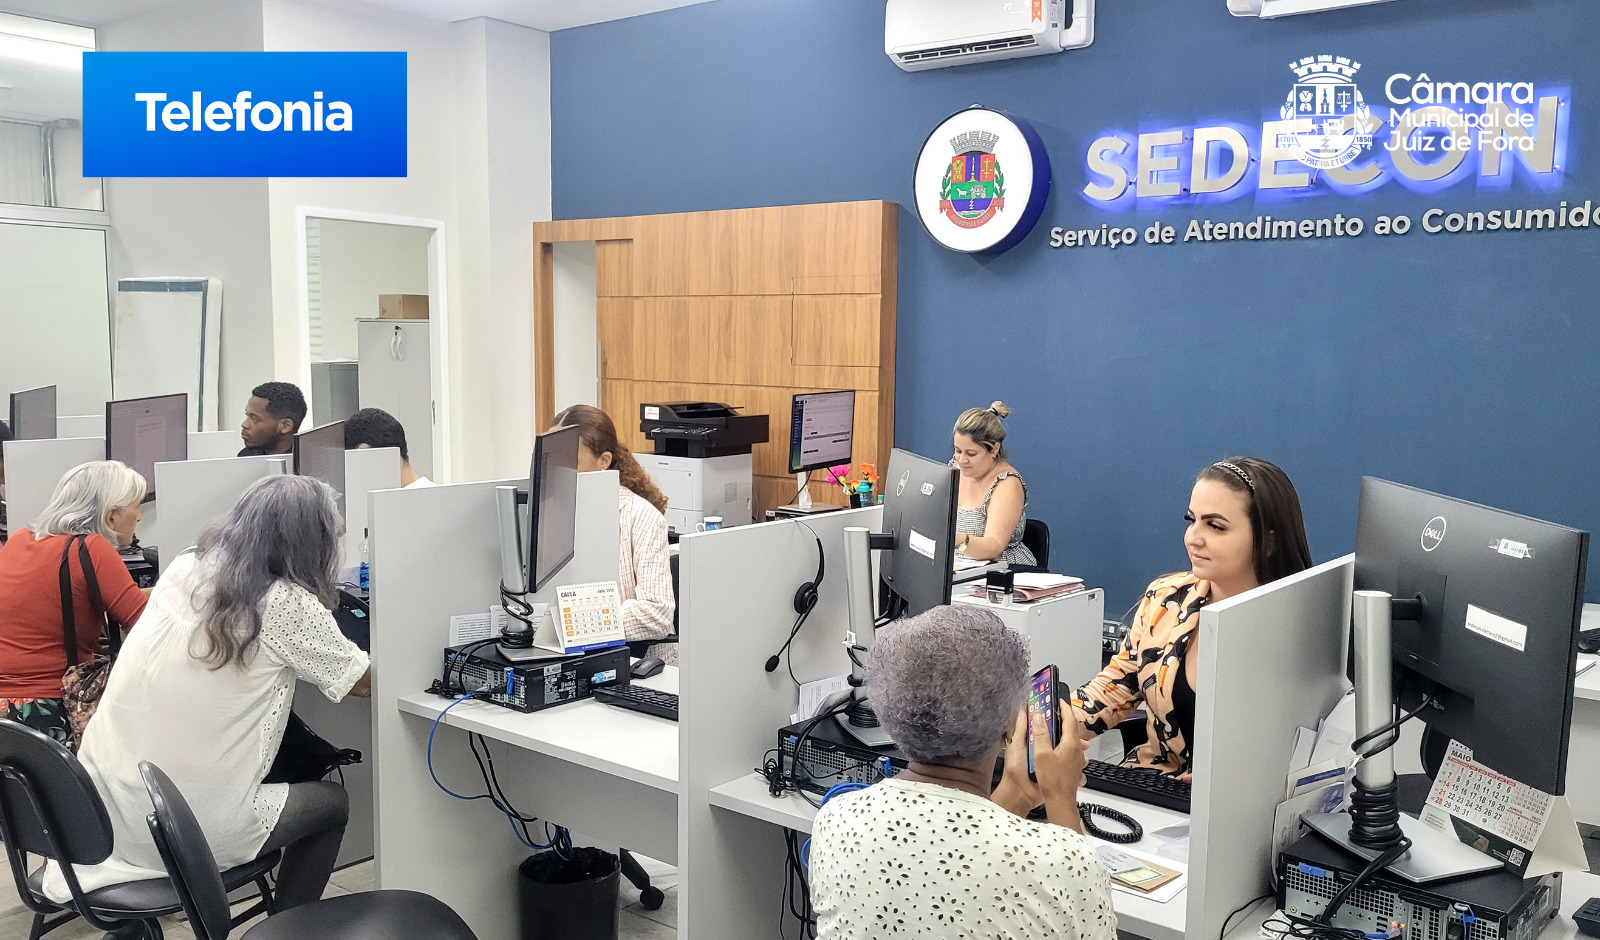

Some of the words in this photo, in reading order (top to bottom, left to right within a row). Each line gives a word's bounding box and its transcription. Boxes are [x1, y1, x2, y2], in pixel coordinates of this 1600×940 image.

[1050, 224, 1137, 248] Serviço
[1144, 222, 1176, 244] de
[1184, 213, 1364, 242] Atendimento
[1374, 214, 1411, 235] ao
[1425, 527, 1441, 540] DELL
[1451, 750, 1471, 762] MAIO
[1492, 791, 1499, 799] 12
[1453, 804, 1460, 812] 30
[1465, 800, 1473, 808] 24
[1474, 804, 1482, 812] 25
[1484, 808, 1492, 816] 26
[1494, 812, 1502, 820] 27
[1497, 804, 1505, 812] 20
